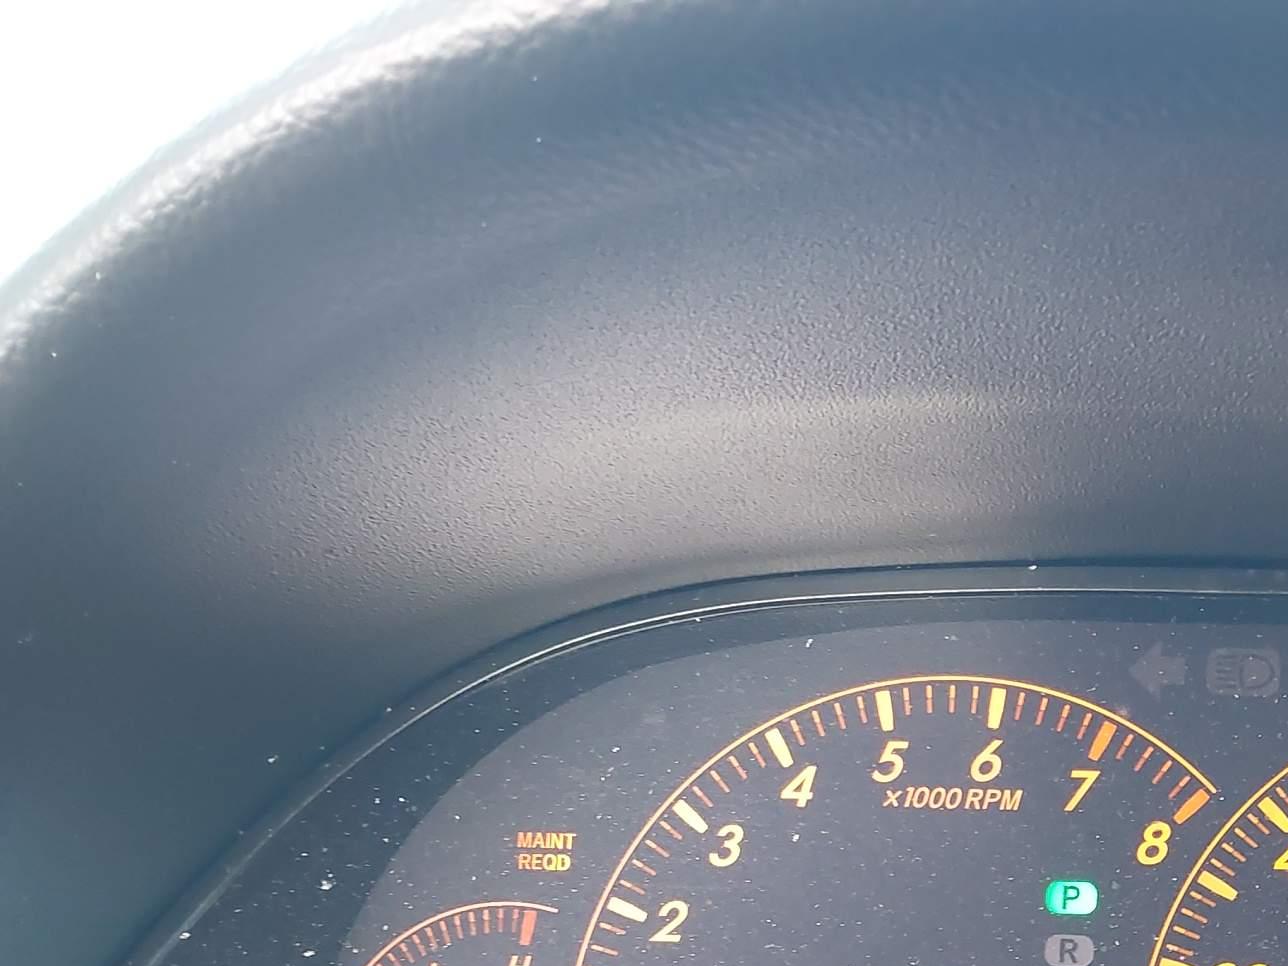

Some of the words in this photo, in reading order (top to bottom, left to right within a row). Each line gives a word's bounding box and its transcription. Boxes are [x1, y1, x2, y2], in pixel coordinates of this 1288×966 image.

[871, 742, 909, 783] 5
[970, 741, 1004, 783] 6
[781, 765, 818, 808] 4
[964, 788, 1023, 811] RPM
[1063, 769, 1101, 811] 7
[516, 831, 577, 850] MAINT
[709, 824, 745, 867] 3
[1137, 822, 1173, 866] 8
[517, 853, 571, 872] REQD
[1062, 885, 1081, 911] P
[649, 900, 690, 943] 2
[1058, 938, 1078, 964] R
